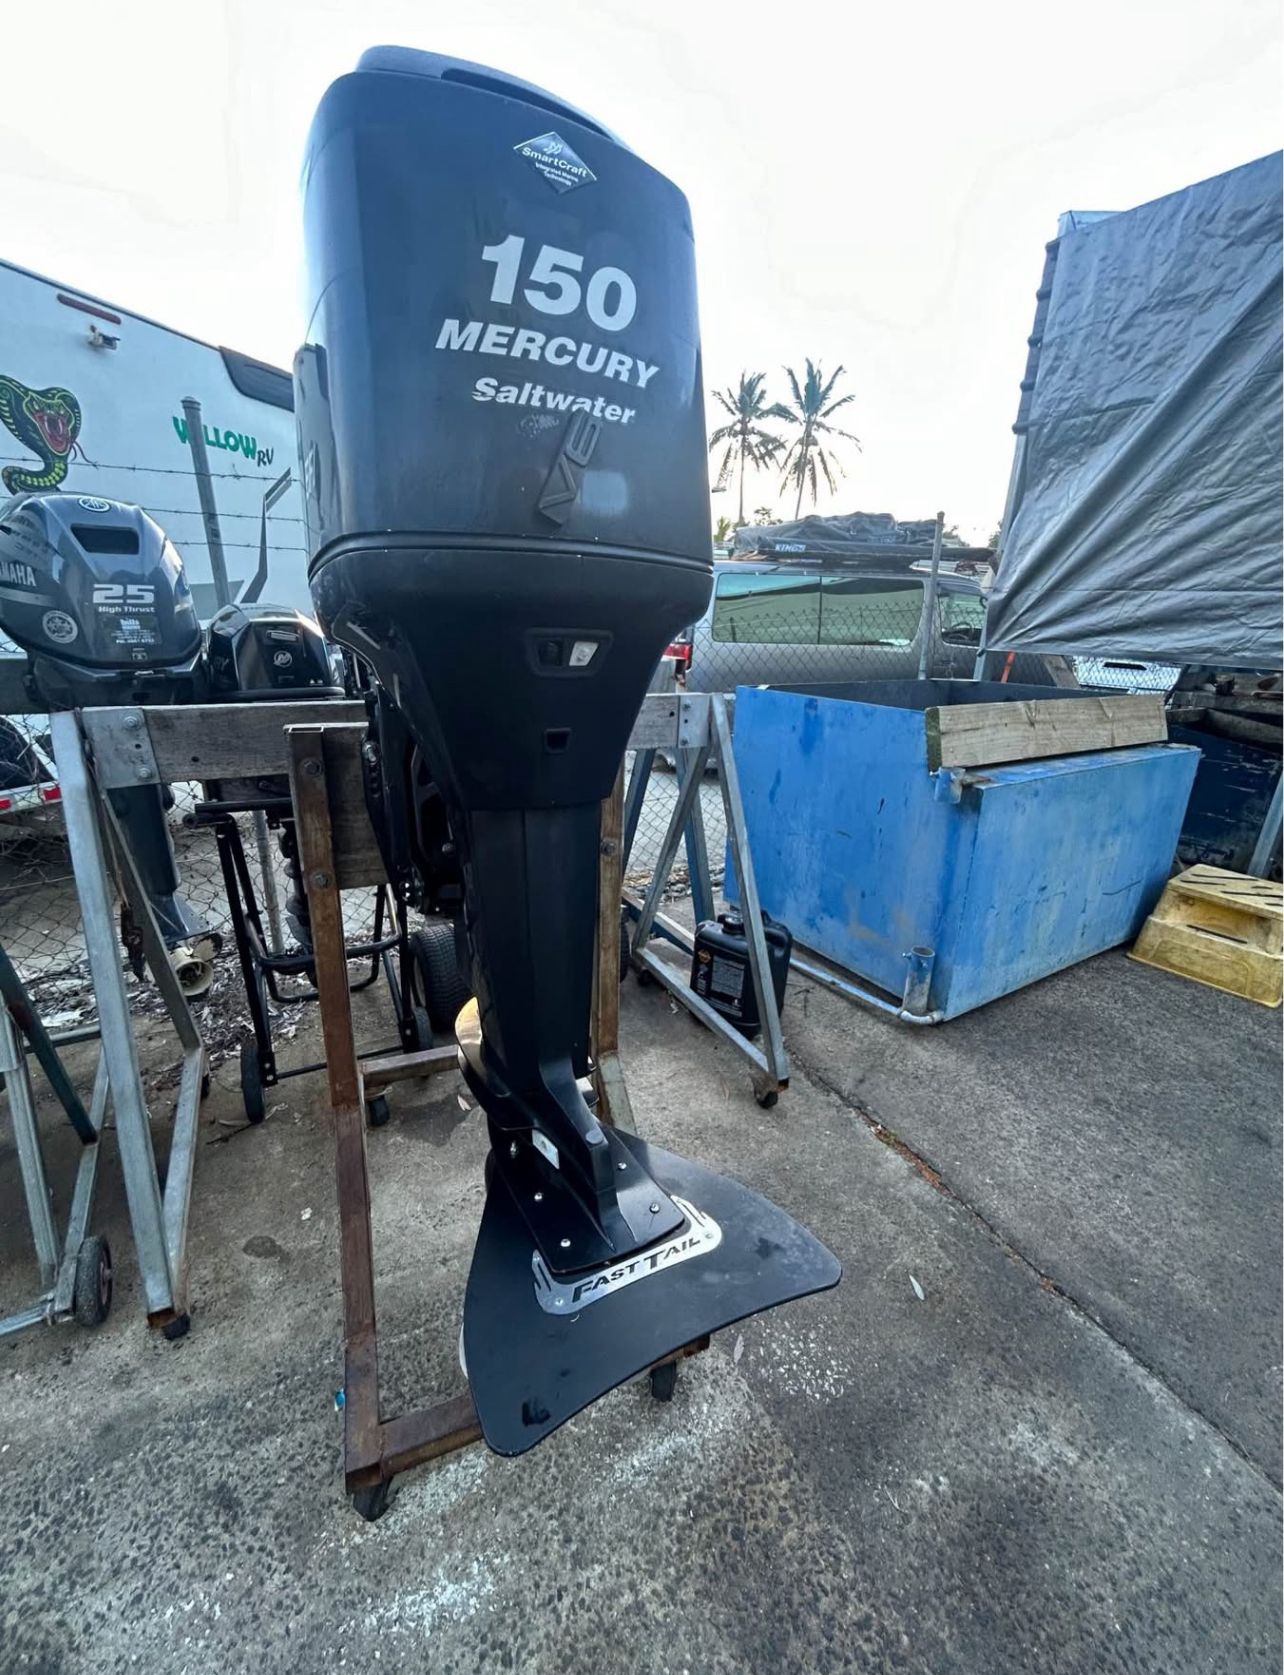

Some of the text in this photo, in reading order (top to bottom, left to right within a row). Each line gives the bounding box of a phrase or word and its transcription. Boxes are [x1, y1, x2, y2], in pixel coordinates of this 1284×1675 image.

[522, 146, 587, 178] SmartCraft
[481, 234, 637, 331] 150
[435, 318, 660, 388] MERCURY
[472, 377, 636, 424] Saltwater
[172, 416, 274, 467] WLLOW RV
[93, 583, 155, 604] 25
[572, 1237, 701, 1303] FAST TAIL
